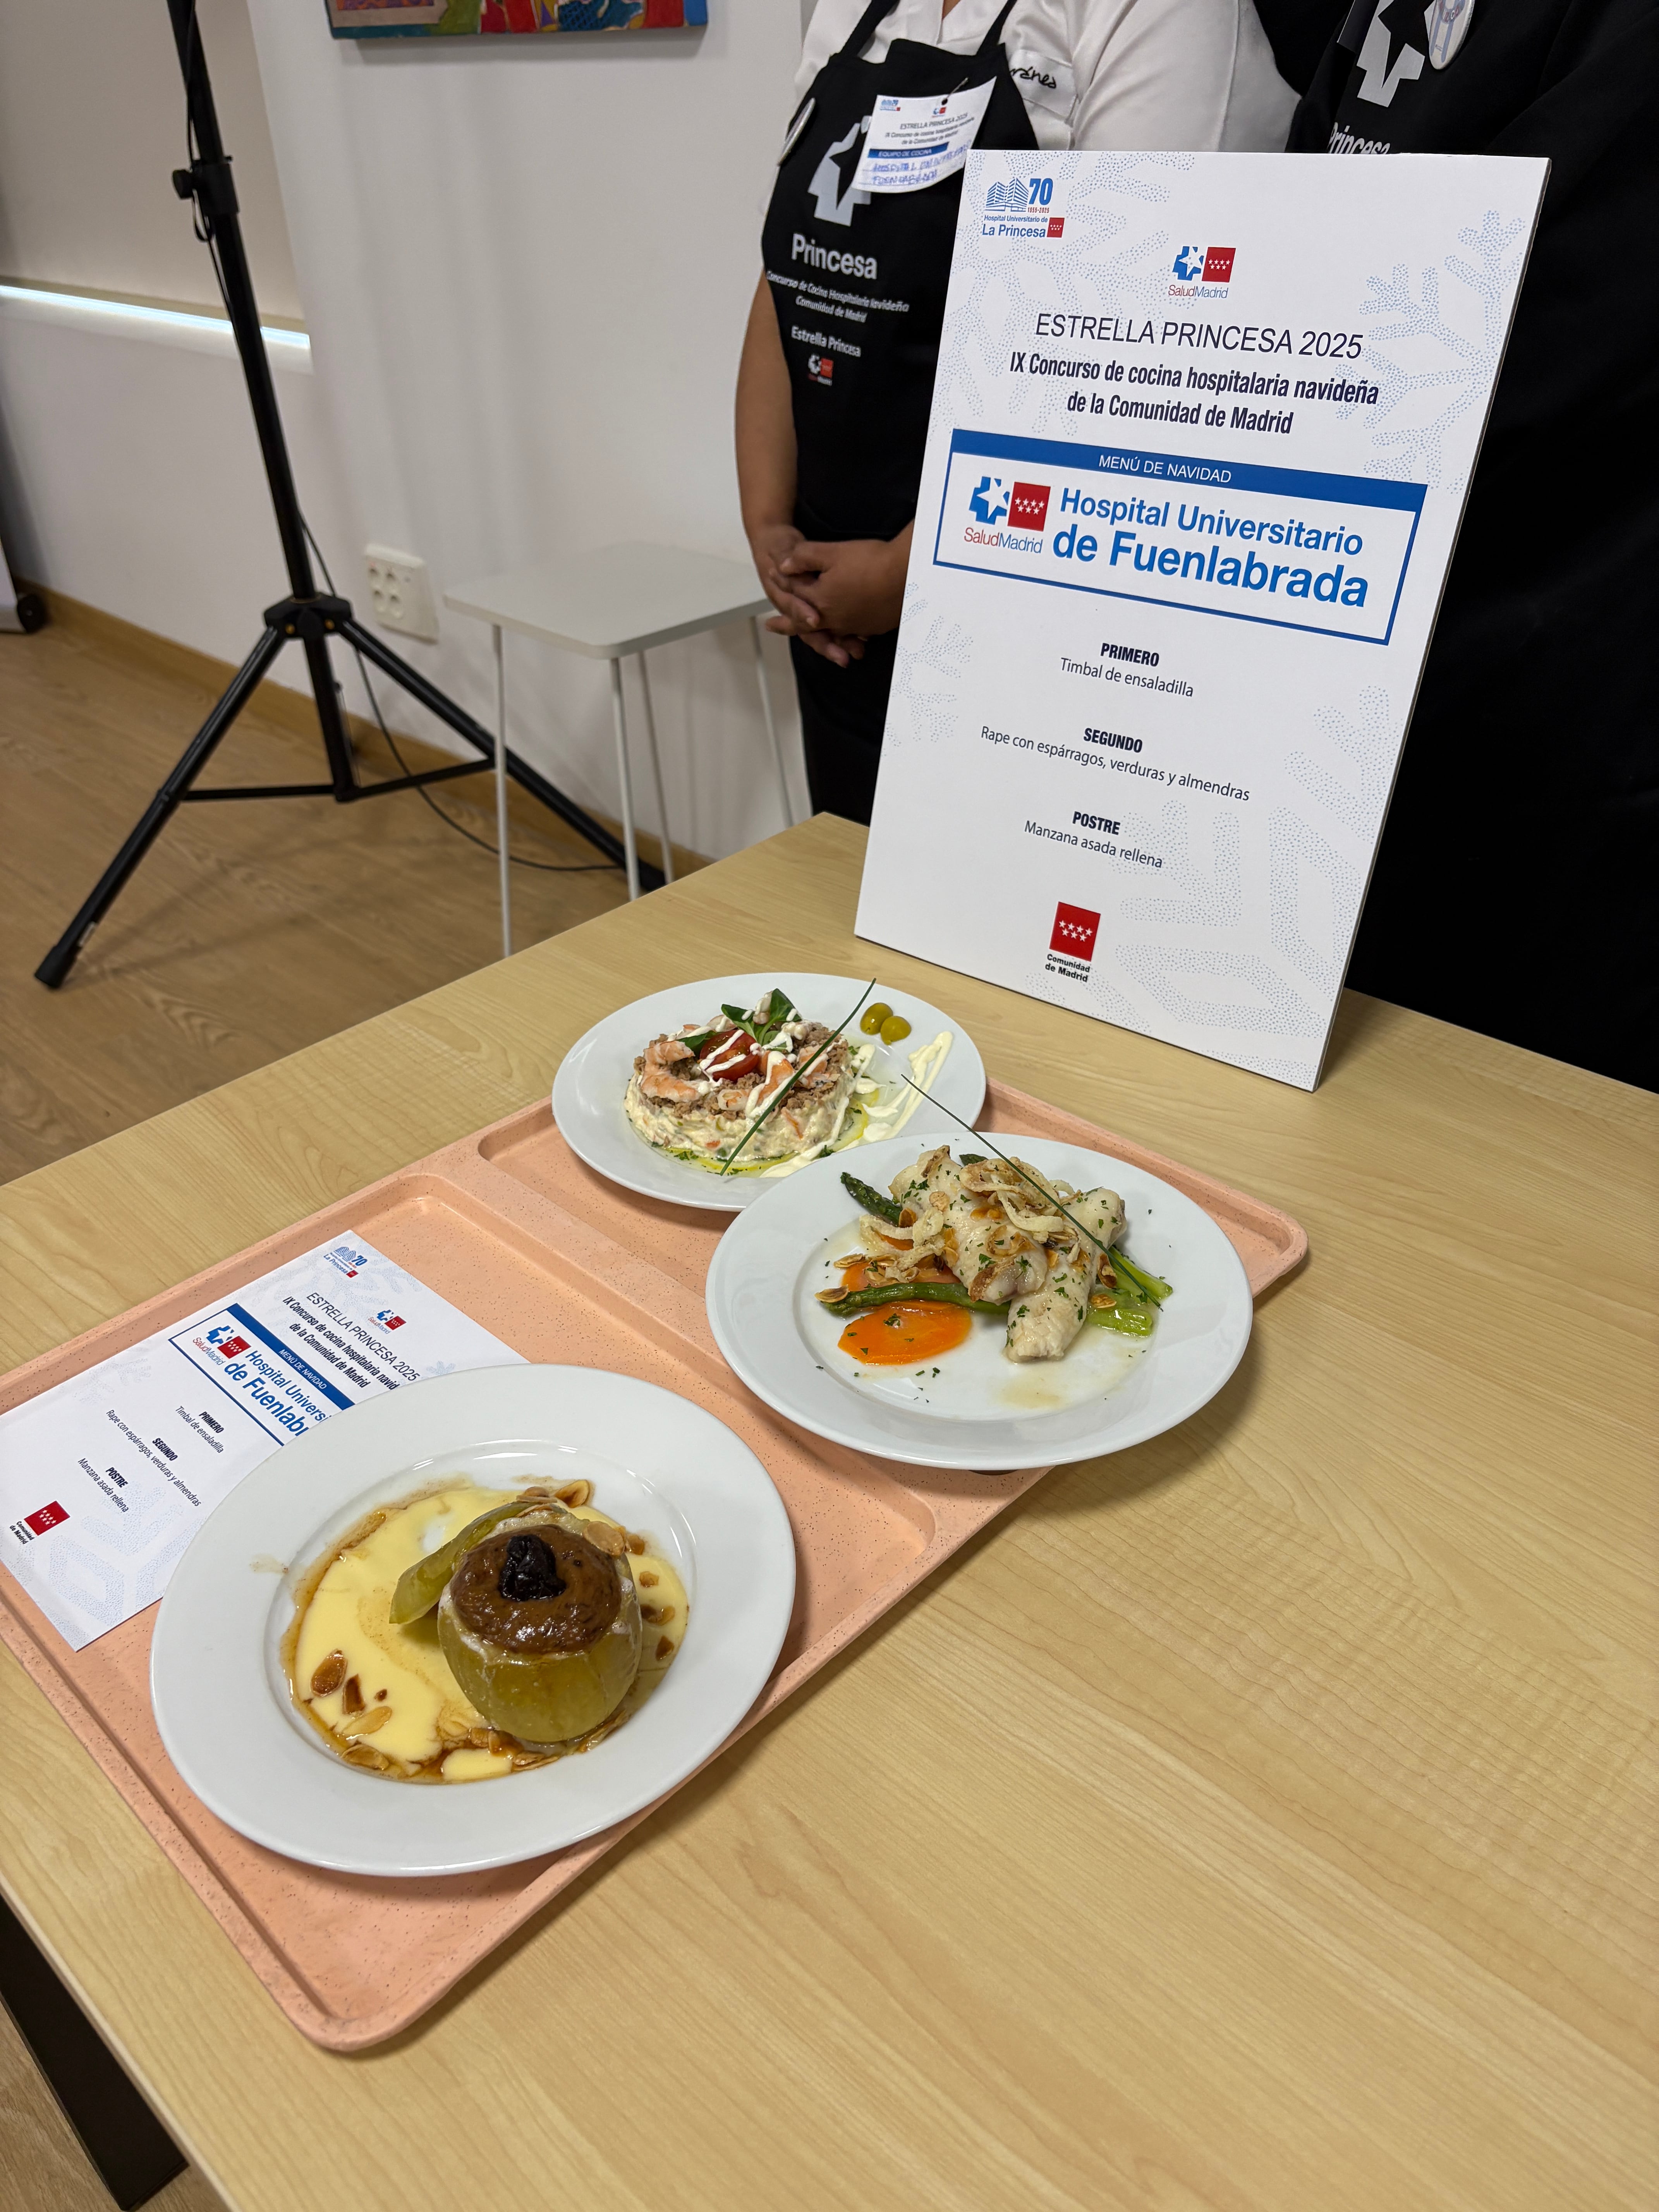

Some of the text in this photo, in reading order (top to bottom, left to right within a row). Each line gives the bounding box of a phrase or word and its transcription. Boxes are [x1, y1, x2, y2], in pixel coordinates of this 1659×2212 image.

[1029, 178, 1053, 205] 70
[982, 223, 1046, 237] La Princesa
[791, 233, 877, 280] Princesa
[1168, 285, 1228, 299] SaludMadrid
[791, 325, 862, 357] Estrella Princesa
[1036, 313, 1363, 359] ESTRELLA PRINCESA 2025
[1010, 352, 1379, 405] IX Concurso de cocina hospitalaria navideña
[1067, 391, 1294, 434] de la Comunidad de Madrid
[1099, 455, 1231, 483] MENÚ DE NAVIDAD
[1060, 488, 1363, 555] Hospital Universitario
[964, 527, 1043, 553] SaludMadrid
[1053, 524, 1368, 607] de Fuenlabrada
[1100, 642, 1159, 667] PRIMERO
[1060, 657, 1194, 697] Timbal de ensaladilla
[1083, 728, 1143, 753] SEGUNDO
[981, 726, 1250, 802] Rape con espárragos, verduras y almendras
[1072, 811, 1121, 835] POSTRE
[1024, 820, 1163, 869] Manzana asada rellena
[1045, 953, 1091, 983] Comunidad de Madrid
[329, 1258, 348, 1274] Princesa
[352, 1255, 368, 1266] 70
[283, 1296, 295, 1305] IX
[290, 1302, 318, 1326] Concurso
[315, 1323, 326, 1332] de
[323, 1330, 345, 1348] cocina
[342, 1345, 381, 1376] hospitalaria
[306, 1292, 421, 1381] ESTRELLA PRINCESA 2025
[368, 1317, 391, 1334] SaludMadrid
[192, 1337, 227, 1366] SaludMadrid
[289, 1322, 371, 1388] de la Comunidad de Madrid
[224, 1362, 249, 1381] de
[245, 1350, 292, 1388] Hospital
[279, 1349, 327, 1389] MENÚ DE NAVIDAD
[175, 1405, 224, 1453] Timbal de ensaladilla
[199, 1411, 224, 1434] PRIMERO
[106, 1409, 120, 1424] Rape
[117, 1422, 128, 1432] con
[125, 1430, 152, 1458] espárragos,
[150, 1455, 173, 1478] verduras
[173, 1479, 201, 1507] almendras
[152, 1437, 178, 1461] SEGUNDO
[77, 1458, 129, 1513] Manzana asada rellena
[105, 1467, 129, 1488] POSTRE
[14, 1530, 29, 1545] Madrid
[16, 1521, 35, 1540] Comunidad
